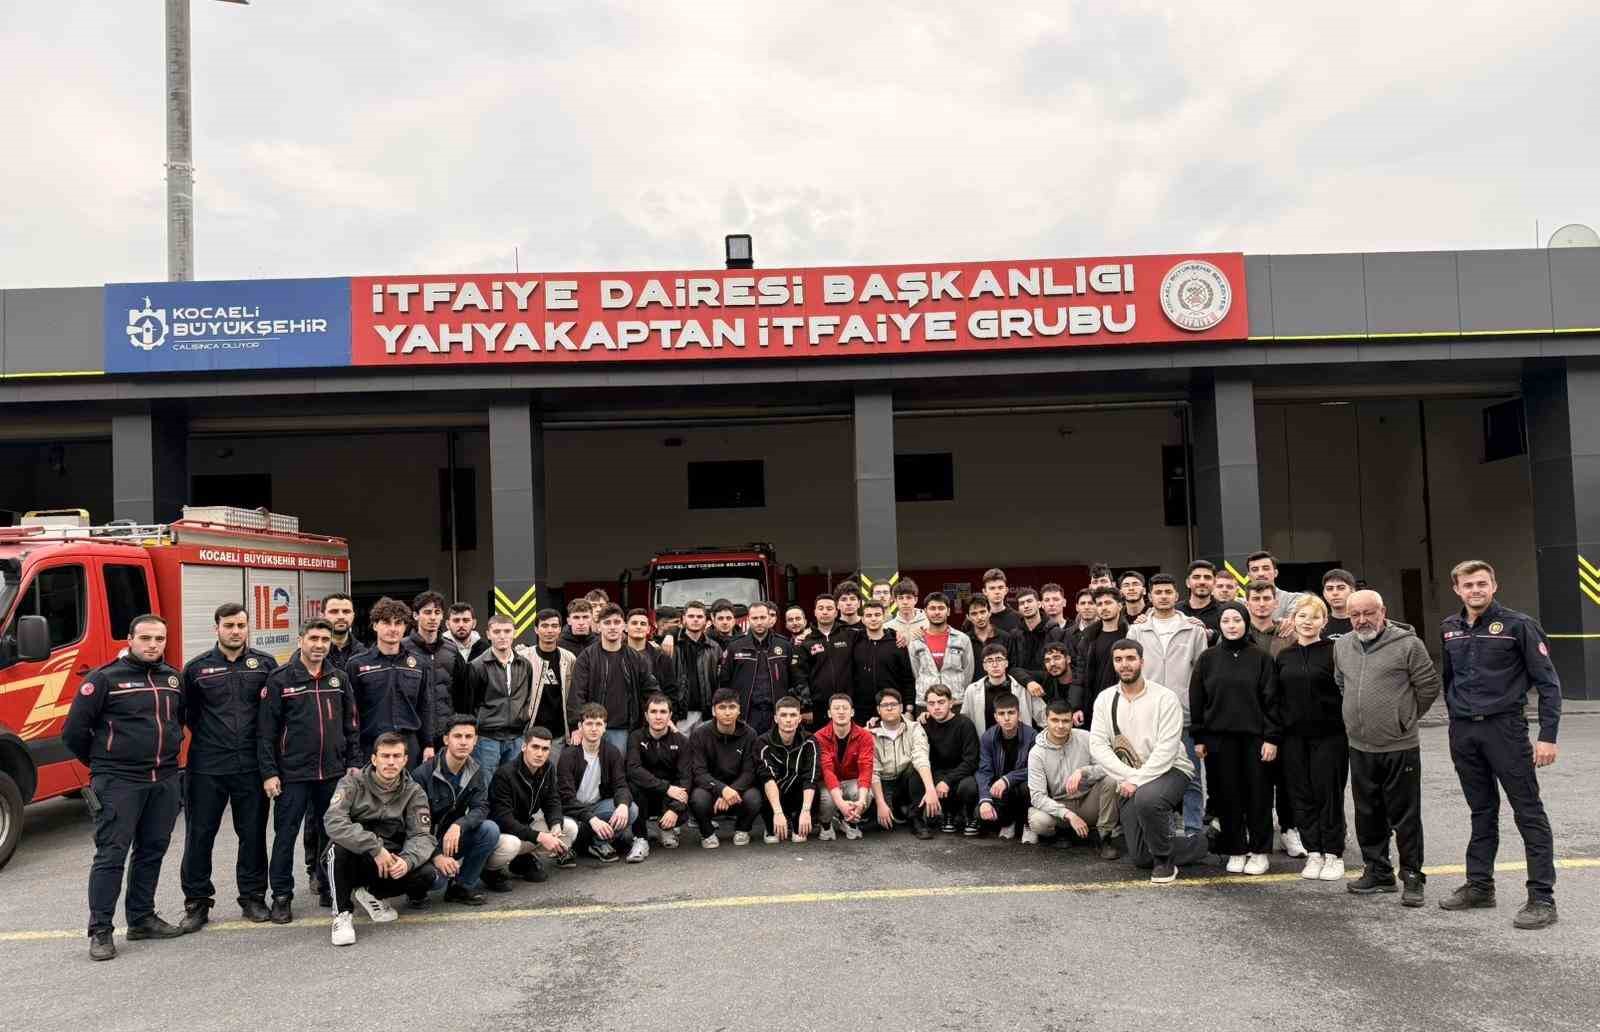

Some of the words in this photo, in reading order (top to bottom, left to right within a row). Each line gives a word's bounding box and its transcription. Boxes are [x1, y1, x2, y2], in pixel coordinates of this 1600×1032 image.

[372, 280, 579, 313] İTFAİYE
[600, 275, 804, 309] DAİRESİ
[173, 306, 260, 320] KOCAELİ
[173, 318, 328, 337] BÜYÜKŞEHİR
[373, 318, 746, 354] YAHYAKAPTAN
[758, 311, 957, 347] İTFAİYE
[967, 303, 1137, 339] GRUBU
[199, 549, 241, 563] KOCAELİ
[243, 552, 296, 567] BÜYÜKŞEHİR
[254, 585, 290, 630] 112
